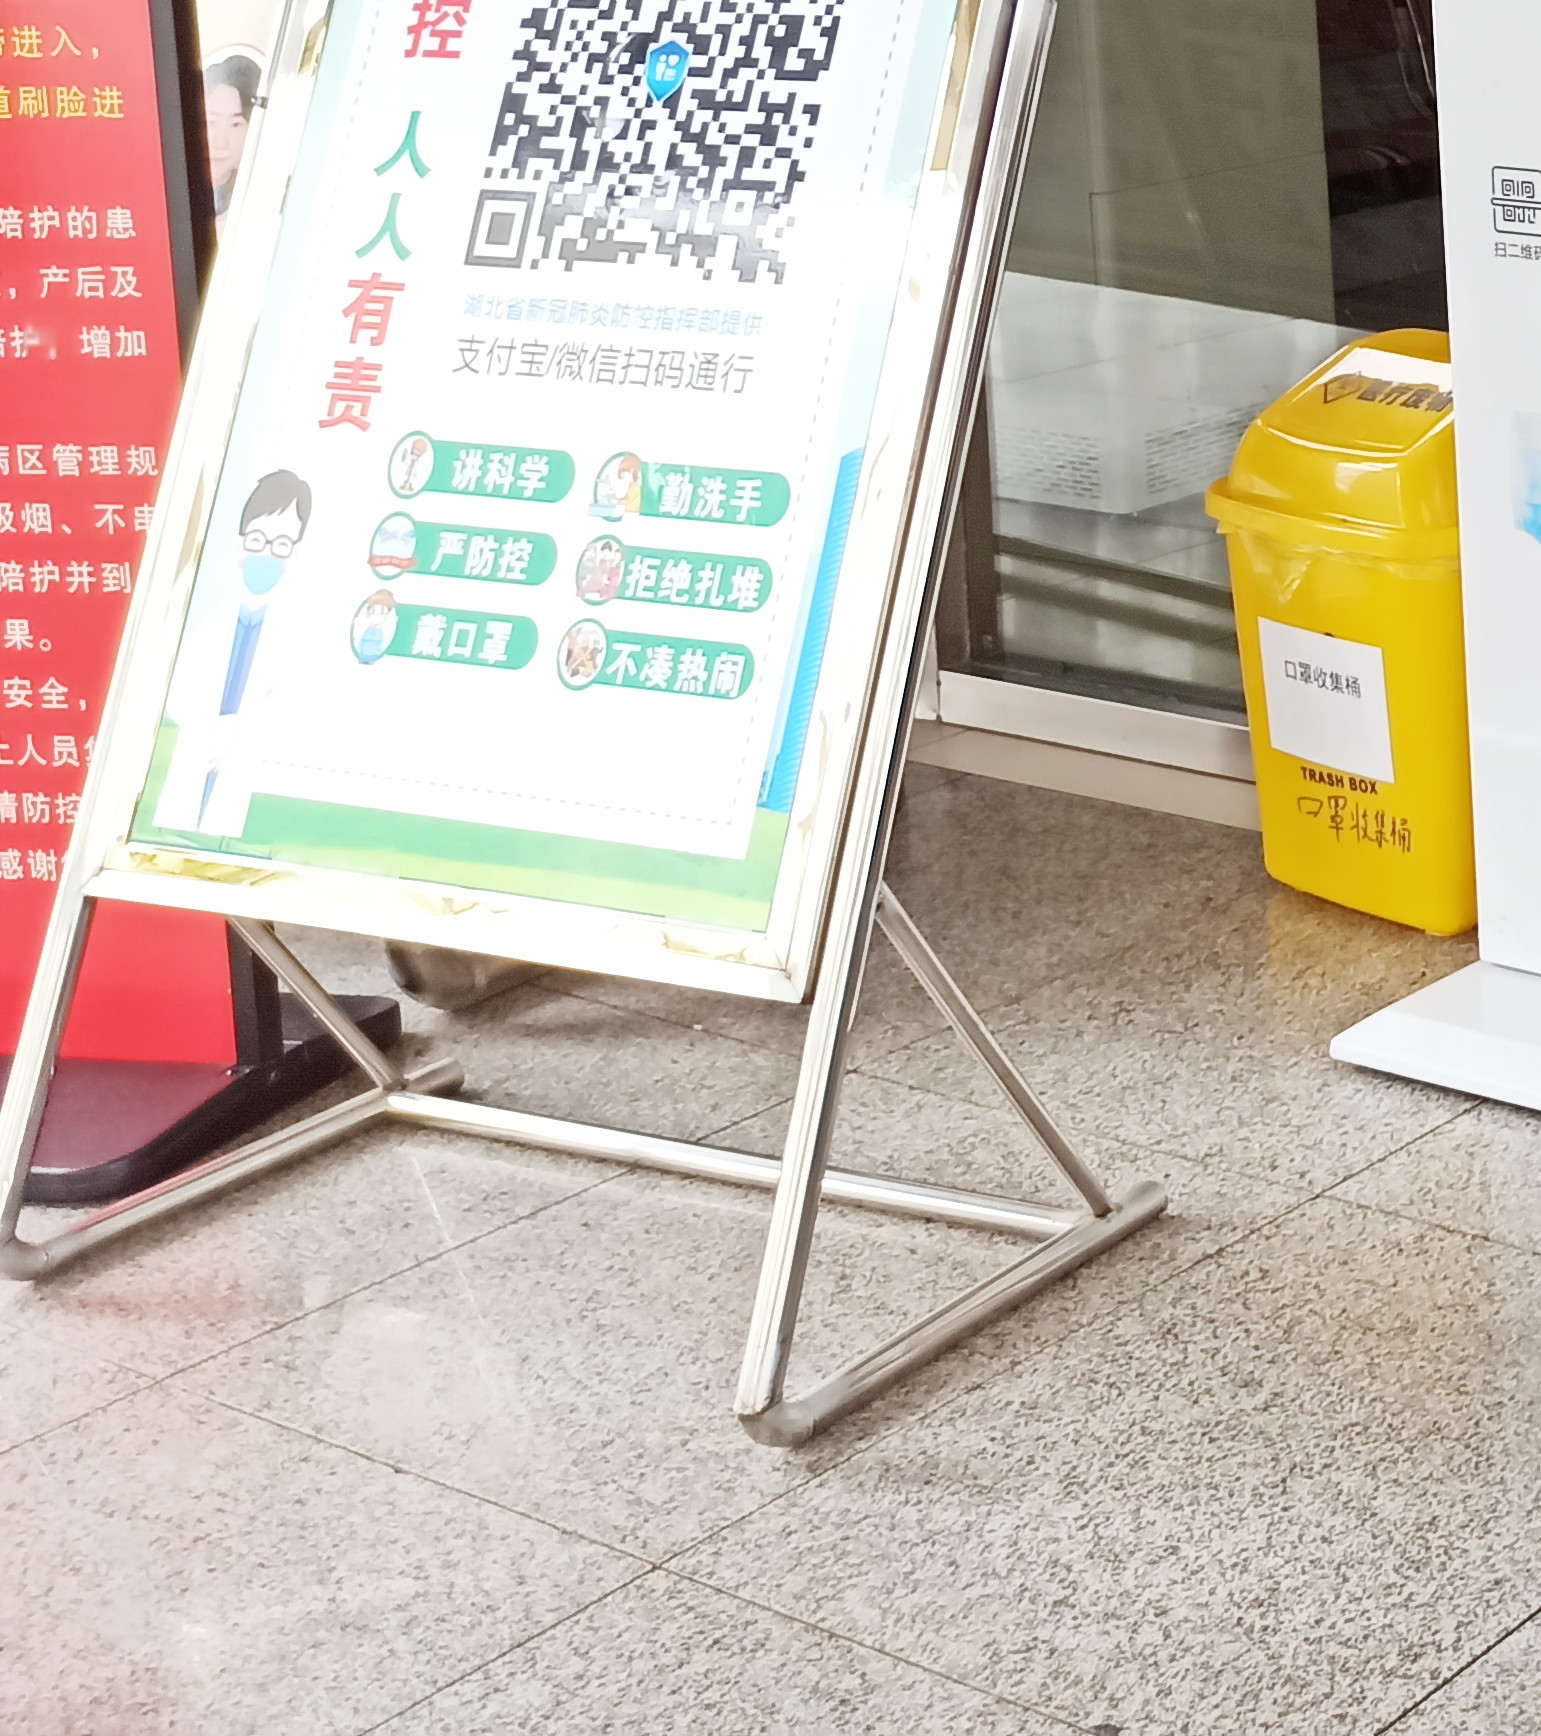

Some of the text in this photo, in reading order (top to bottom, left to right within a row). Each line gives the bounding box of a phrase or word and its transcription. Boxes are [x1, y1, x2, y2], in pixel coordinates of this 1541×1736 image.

[0, 25, 99, 60] 进入，
[318, 110, 432, 432] 人人有责
[452, 334, 755, 394] 支付宝/微信扫码通行
[451, 447, 763, 521] 讲科学 勤洗手
[431, 530, 765, 611] 严防控 拒绝扎堆
[410, 612, 747, 698] 戴口罩 不凑热闹
[1284, 659, 1362, 699] 口罩收集桶
[1300, 766, 1379, 795] TRASH BOX
[1297, 795, 1412, 853] 口罩收集桶
[0, 847, 68, 882] 感谢
